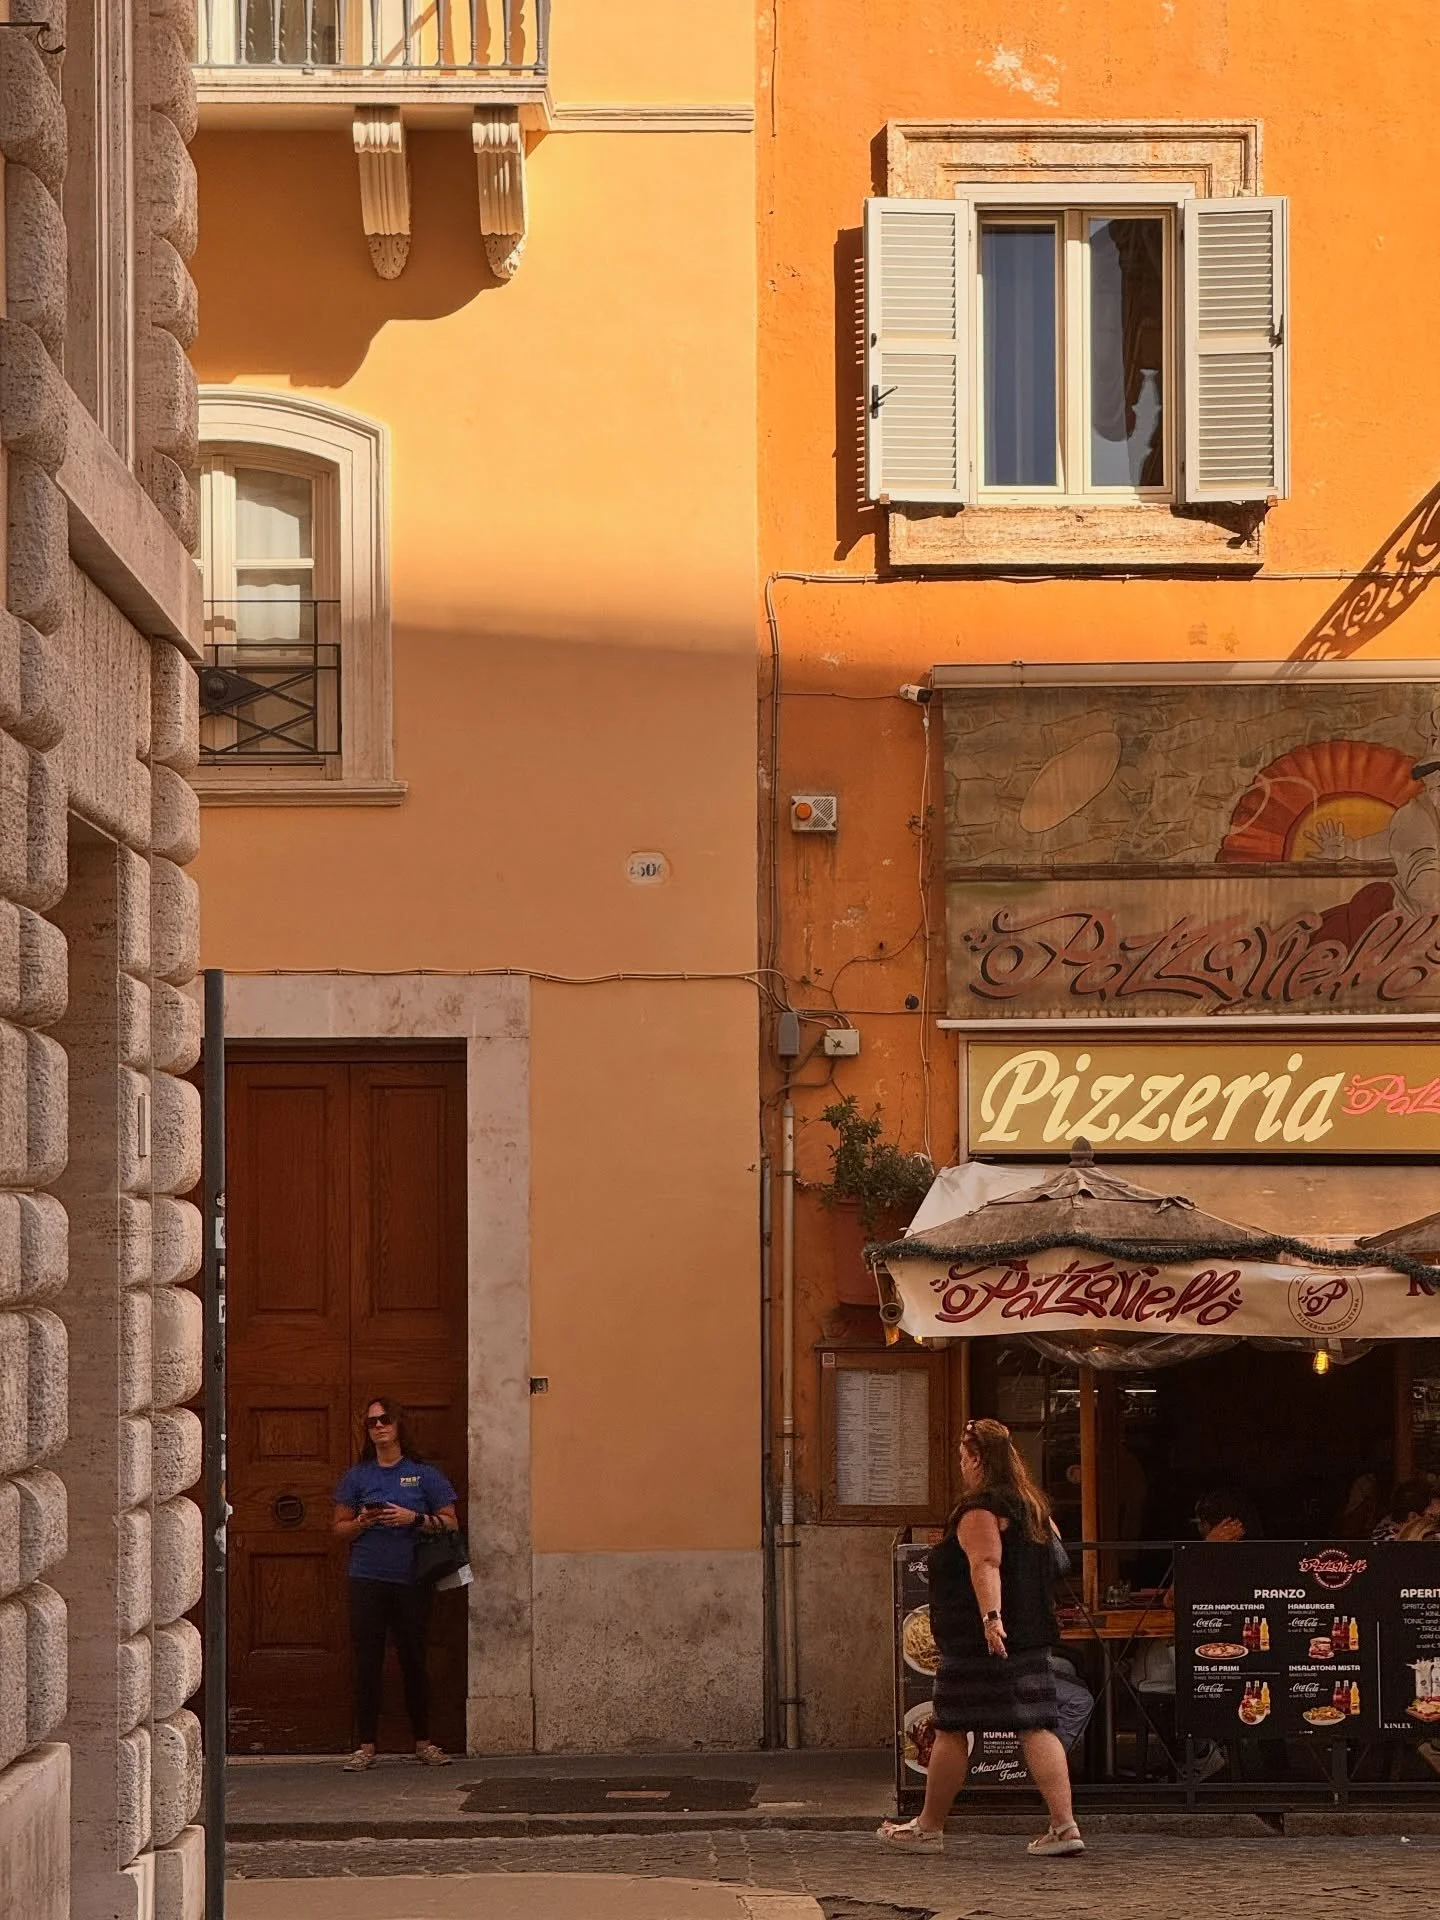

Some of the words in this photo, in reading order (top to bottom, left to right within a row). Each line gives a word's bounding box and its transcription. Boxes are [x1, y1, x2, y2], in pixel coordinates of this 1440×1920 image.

[977, 1049, 1345, 1143] Pizzeria
[1296, 1312, 1325, 1331] PIZZERIA
[1328, 1298, 1360, 1331] NAPOLETANA
[1254, 1589, 1306, 1599] PRANZO
